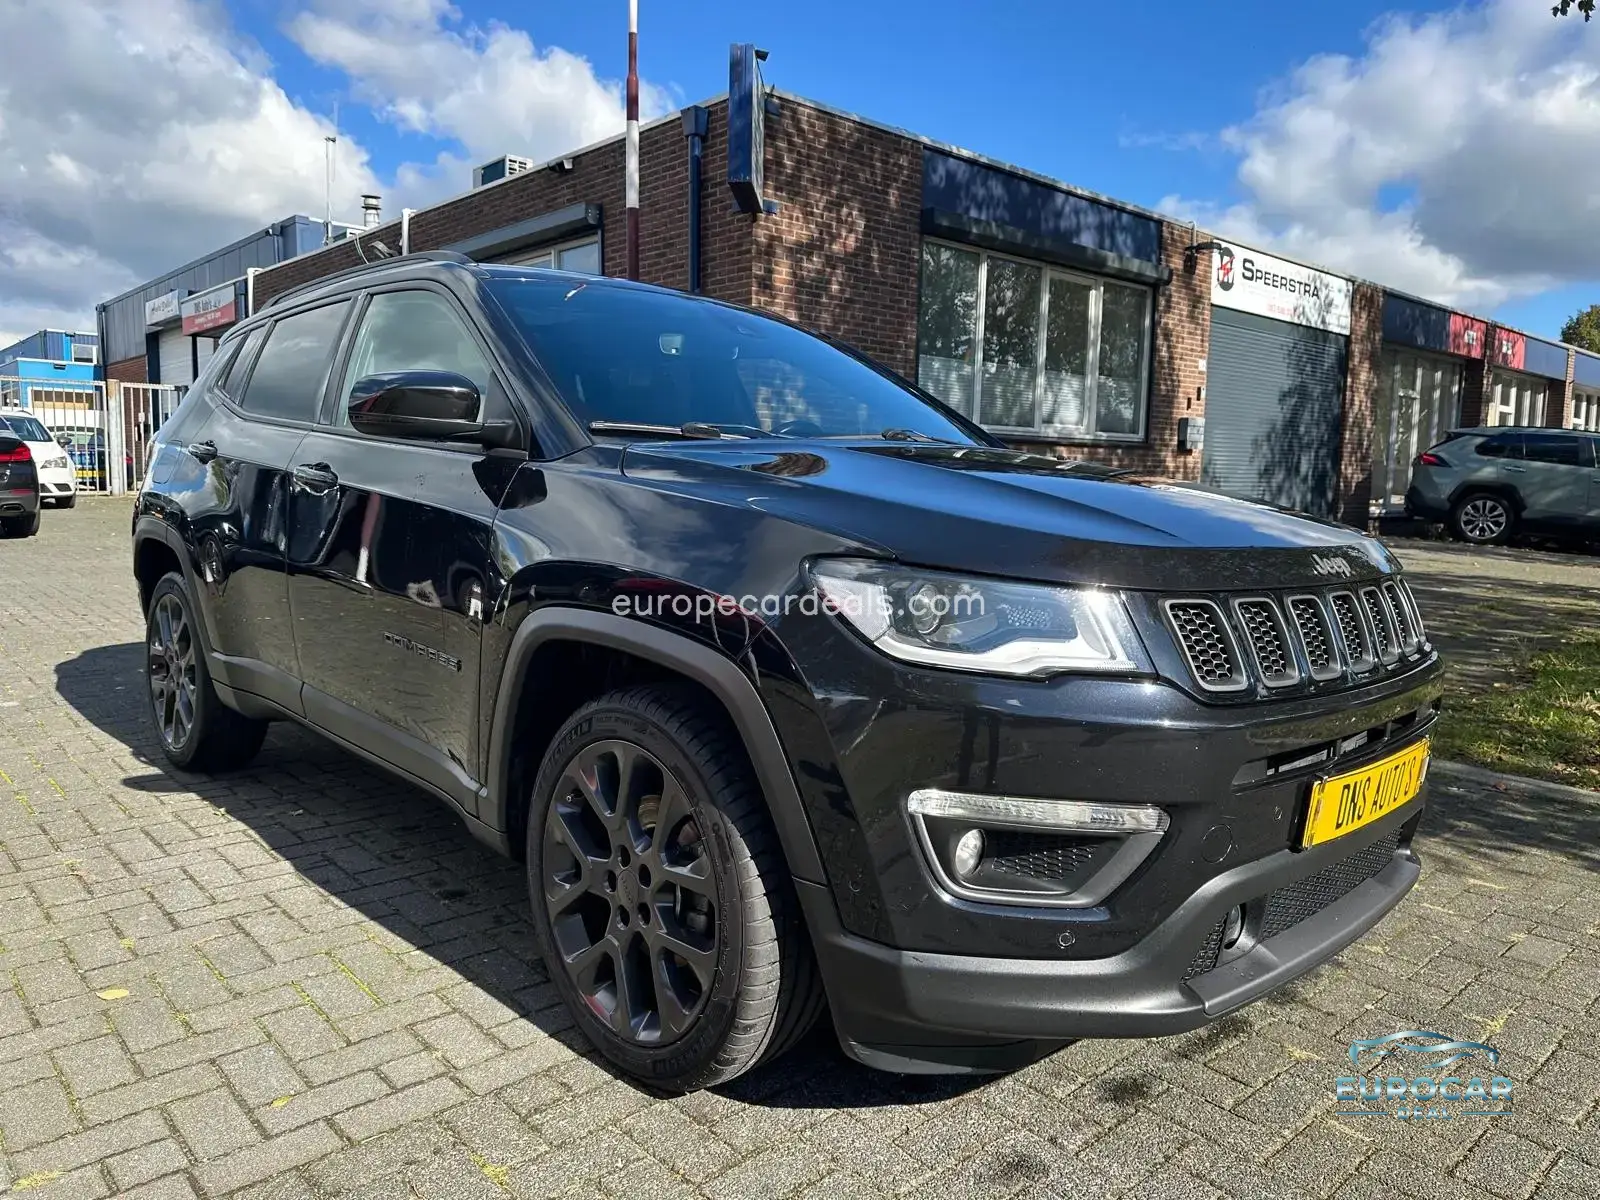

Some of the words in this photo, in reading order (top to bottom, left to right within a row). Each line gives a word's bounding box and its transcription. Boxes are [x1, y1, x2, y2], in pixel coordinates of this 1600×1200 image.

[1311, 553, 1351, 579] Jeep
[1335, 776, 1371, 830] DNS
[1369, 756, 1416, 815] AUTO'S
